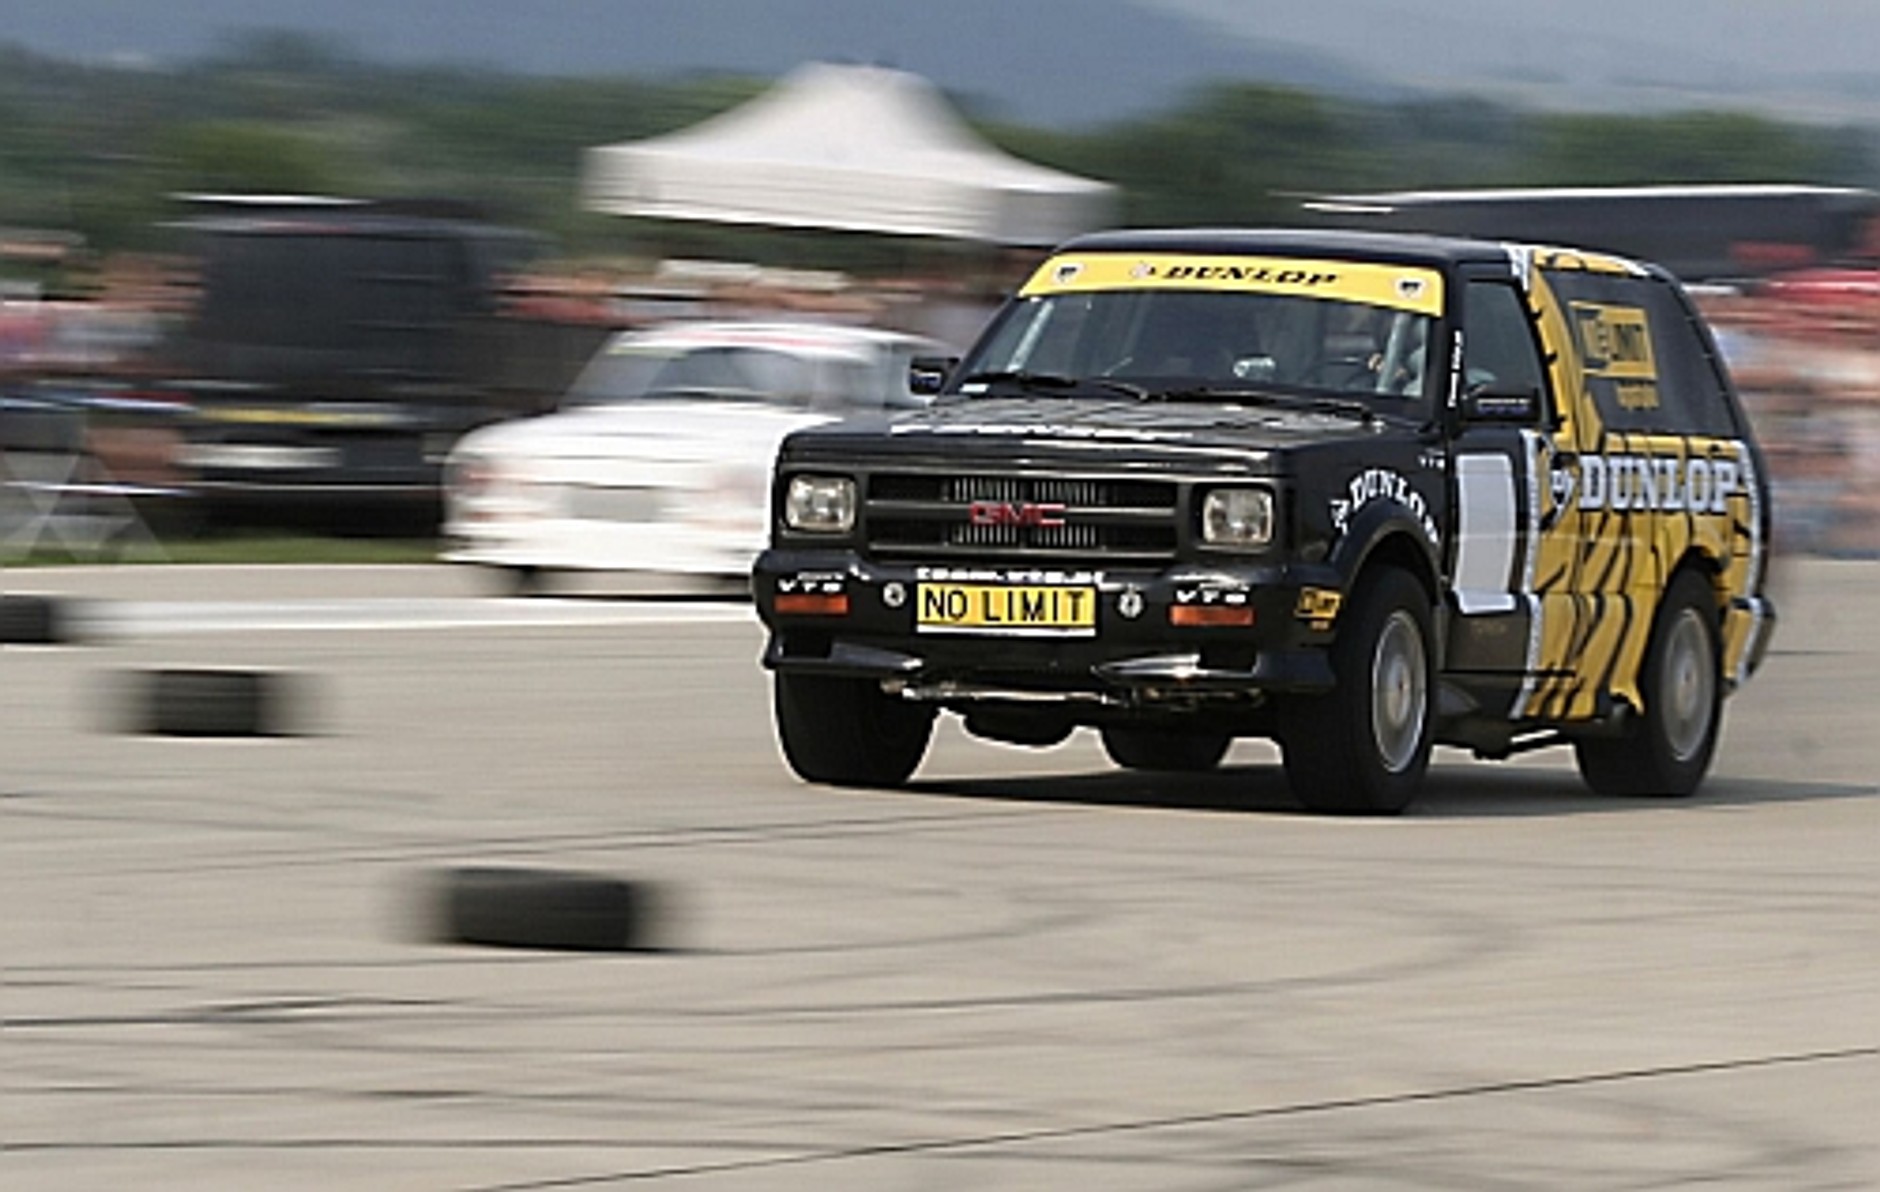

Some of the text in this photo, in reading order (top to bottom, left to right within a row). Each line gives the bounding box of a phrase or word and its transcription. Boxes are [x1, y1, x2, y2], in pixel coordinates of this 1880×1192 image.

[1162, 265, 1339, 285] DUNLOP
[1579, 455, 1737, 513] DUNLOP
[969, 501, 1066, 527] GMC
[924, 590, 1085, 623] NO LIMIT
